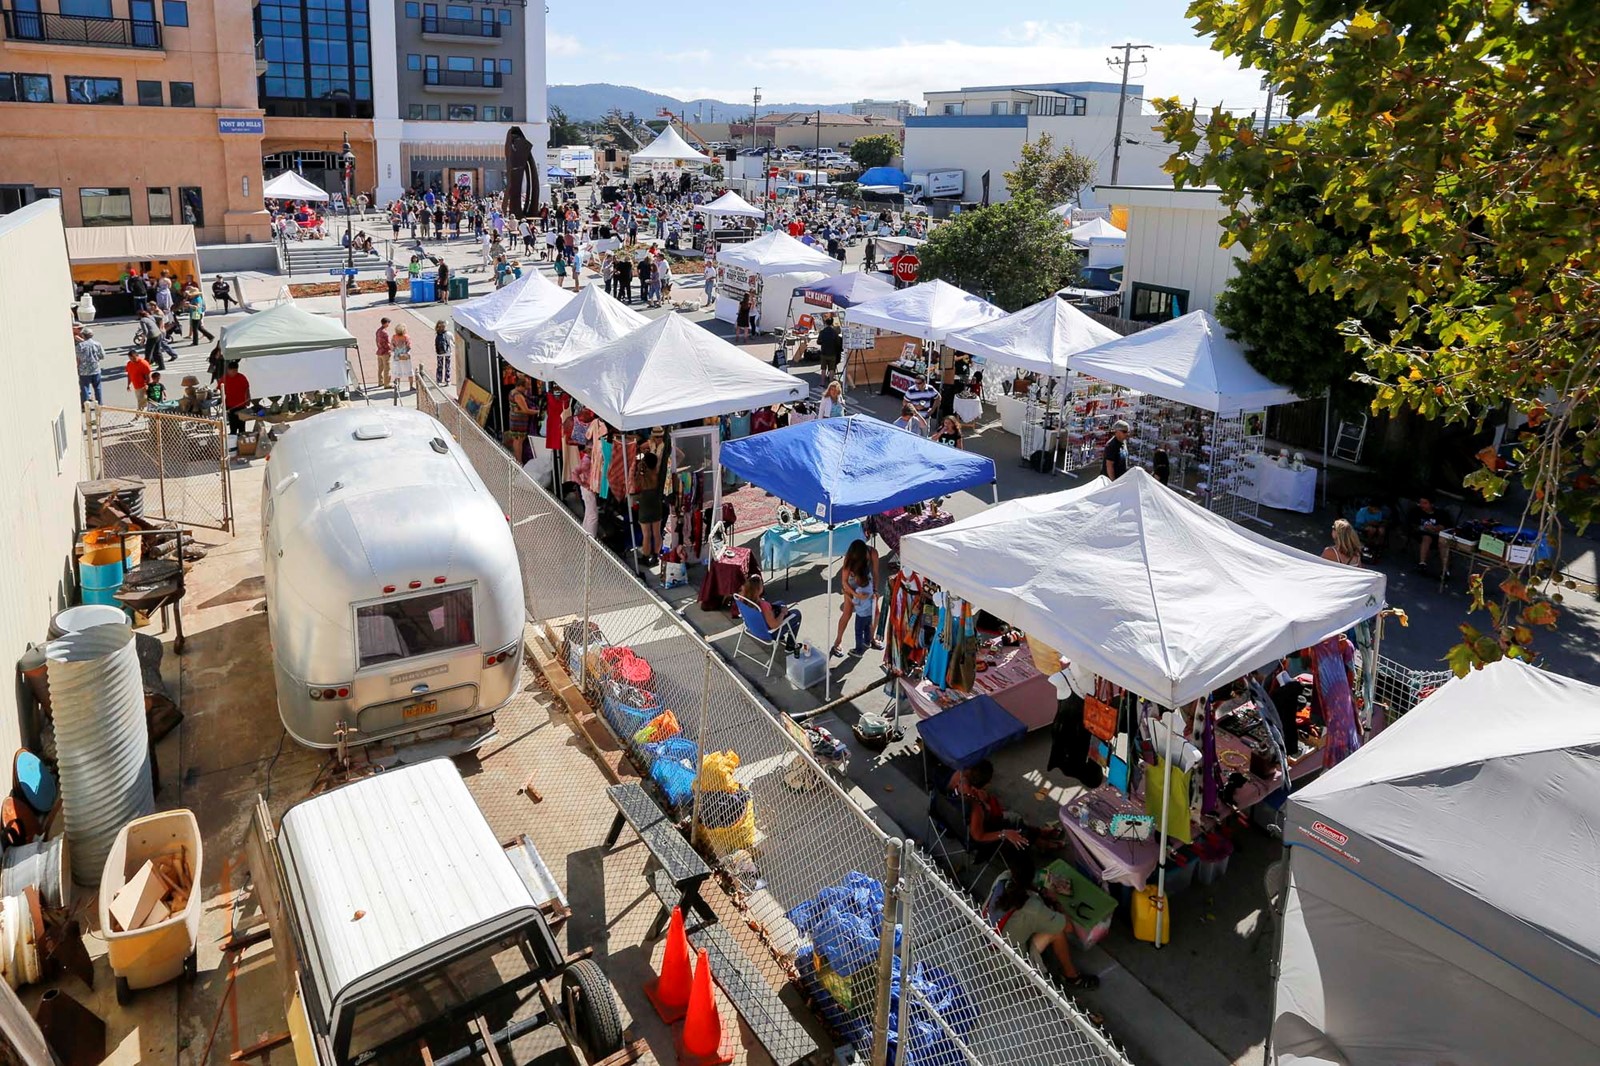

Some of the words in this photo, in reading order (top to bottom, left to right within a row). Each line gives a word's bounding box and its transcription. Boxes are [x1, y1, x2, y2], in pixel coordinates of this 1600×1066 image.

[898, 262, 919, 274] STOP
[805, 290, 815, 299] NEW
[815, 292, 832, 303] CAPITAL
[1314, 822, 1340, 841] Coleman
